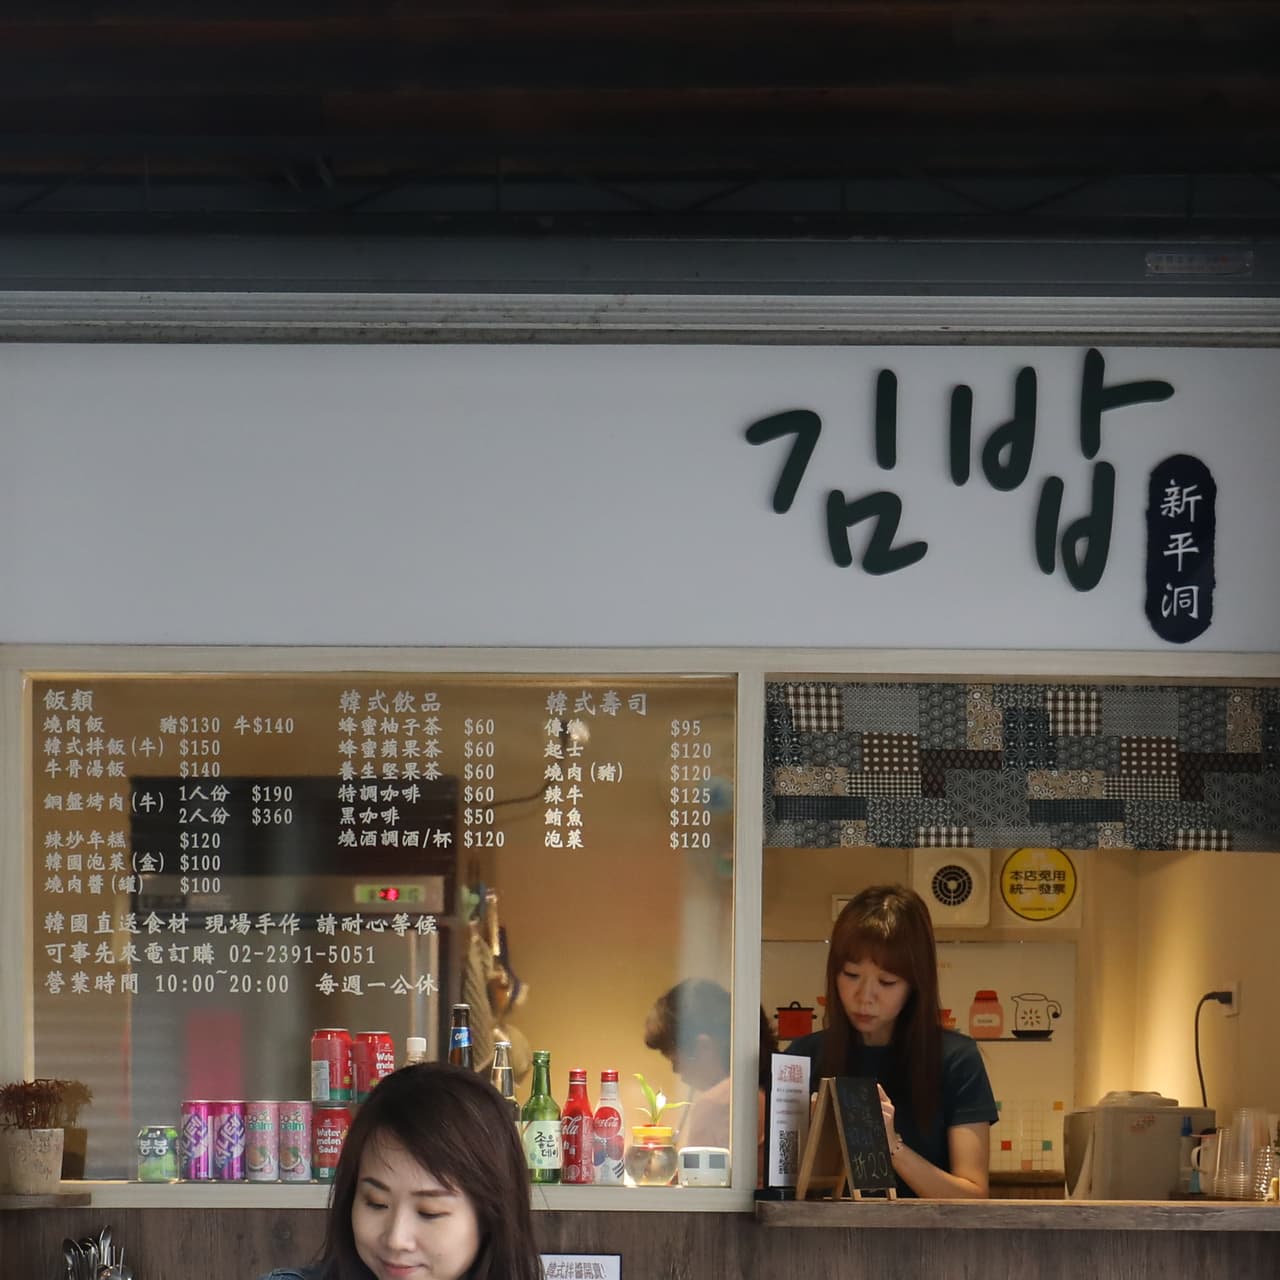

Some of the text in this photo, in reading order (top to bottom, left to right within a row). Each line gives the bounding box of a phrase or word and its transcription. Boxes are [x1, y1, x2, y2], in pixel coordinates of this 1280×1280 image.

[746, 347, 1174, 592] 김밥
[1160, 479, 1202, 620] 新平洞
[43, 689, 93, 711] 飯類
[339, 691, 442, 714] 韓式飲品
[545, 691, 648, 716] 韓式壽司
[43, 715, 105, 734] 燒肉飯
[233, 715, 294, 735] 牛$140
[338, 718, 495, 736] 蜂蜜柚子茶 $60
[671, 720, 701, 737] $95
[43, 736, 220, 757] 韓式拌飯(牛) $150
[338, 740, 495, 759] 蜂蜜蘋果茶 $60
[544, 740, 712, 760] 起士 $120
[44, 759, 220, 779] 牛骨湯飯 $140
[338, 762, 495, 781] 養生堅果茶 $60
[544, 762, 712, 783] 燒肉(豬) $120
[179, 785, 293, 803] 1人份 $190
[338, 785, 495, 804] 特調咖啡 $60
[544, 785, 711, 805] 辣牛 $125
[179, 807, 293, 826] 2人份 $360
[339, 807, 494, 826] 黑咖啡 $50
[544, 807, 711, 827] 鮪魚 $120
[44, 830, 220, 850] 辣炒年糕 $120
[337, 829, 505, 849] 燒酒調酒/杯 $120
[544, 830, 711, 849] 泡菜 $120
[180, 855, 220, 872] $100
[180, 877, 220, 894] $100
[1010, 870, 1066, 881] 本店免用
[43, 912, 439, 936] 韓國直送食材 現場手作 請耐心等候
[45, 942, 376, 965] 可事先來電訂購 02-2391-5051
[46, 972, 139, 995] 營業時間
[315, 974, 439, 996] 每週一公休
[317, 1129, 341, 1138] Water
[317, 1137, 341, 1145] melon
[318, 1145, 338, 1154] Soda
